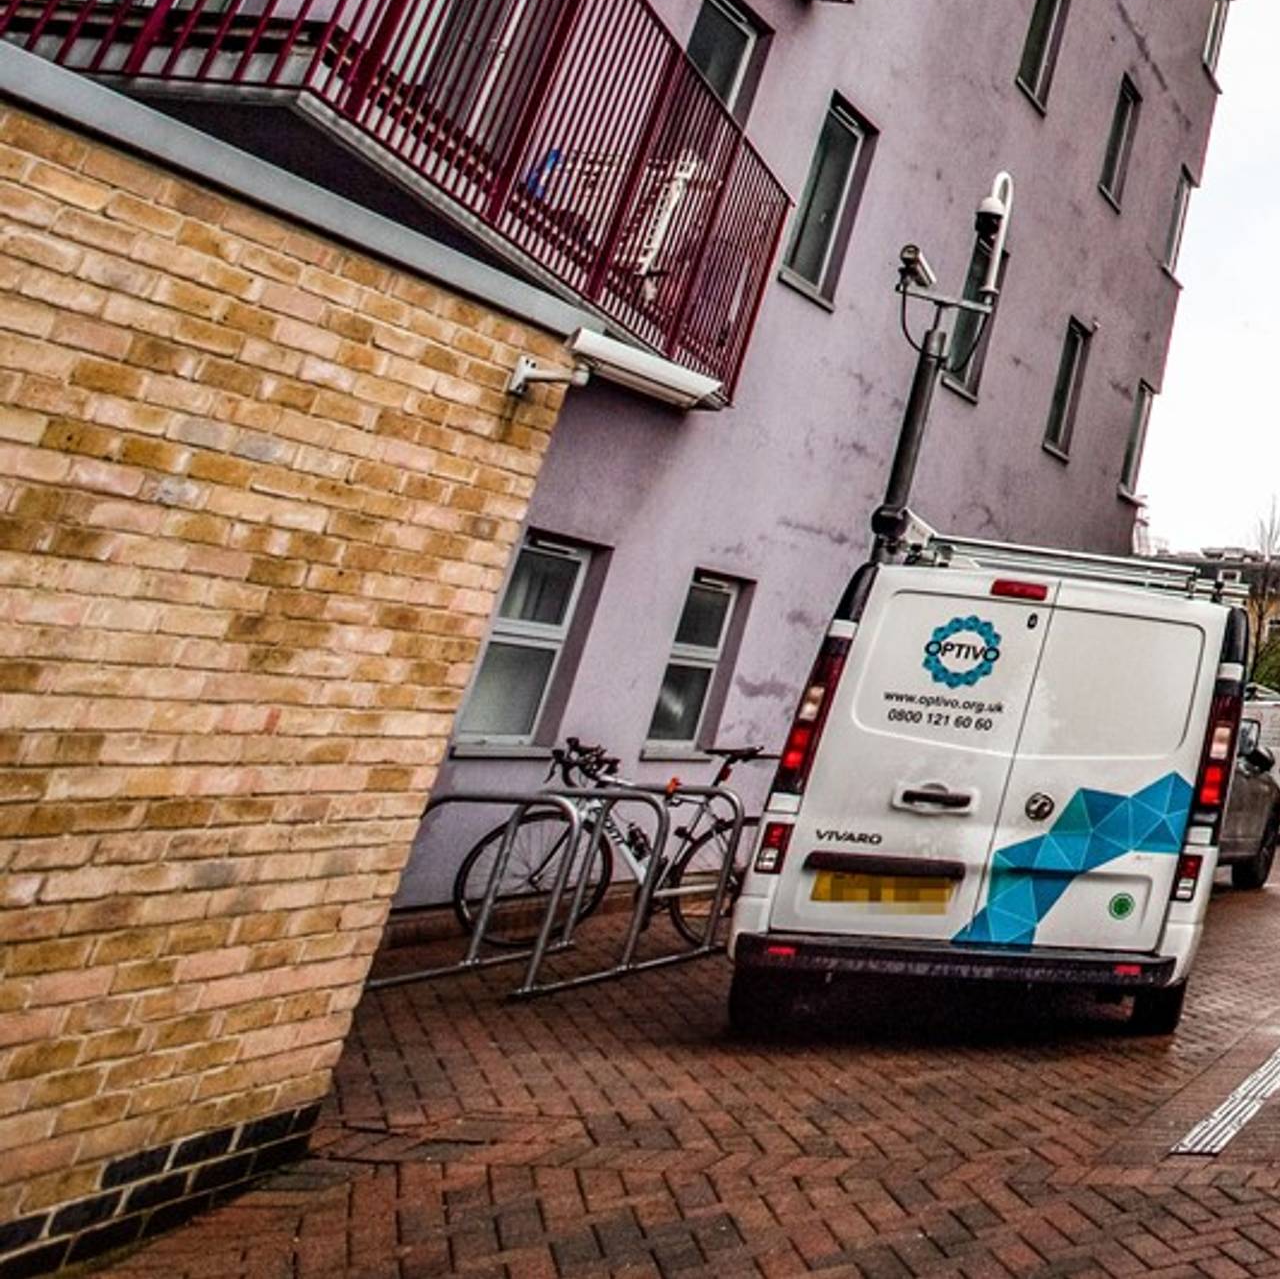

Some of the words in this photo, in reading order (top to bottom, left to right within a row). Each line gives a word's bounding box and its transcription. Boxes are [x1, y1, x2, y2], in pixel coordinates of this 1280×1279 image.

[925, 640, 1000, 663] OPTIVO
[884, 691, 1003, 714] www.optivo.org.uk
[888, 708, 922, 723] 0800
[926, 712, 950, 726] 121
[953, 715, 972, 729] 60
[974, 718, 993, 731] 60
[816, 829, 882, 845] VIVARO
